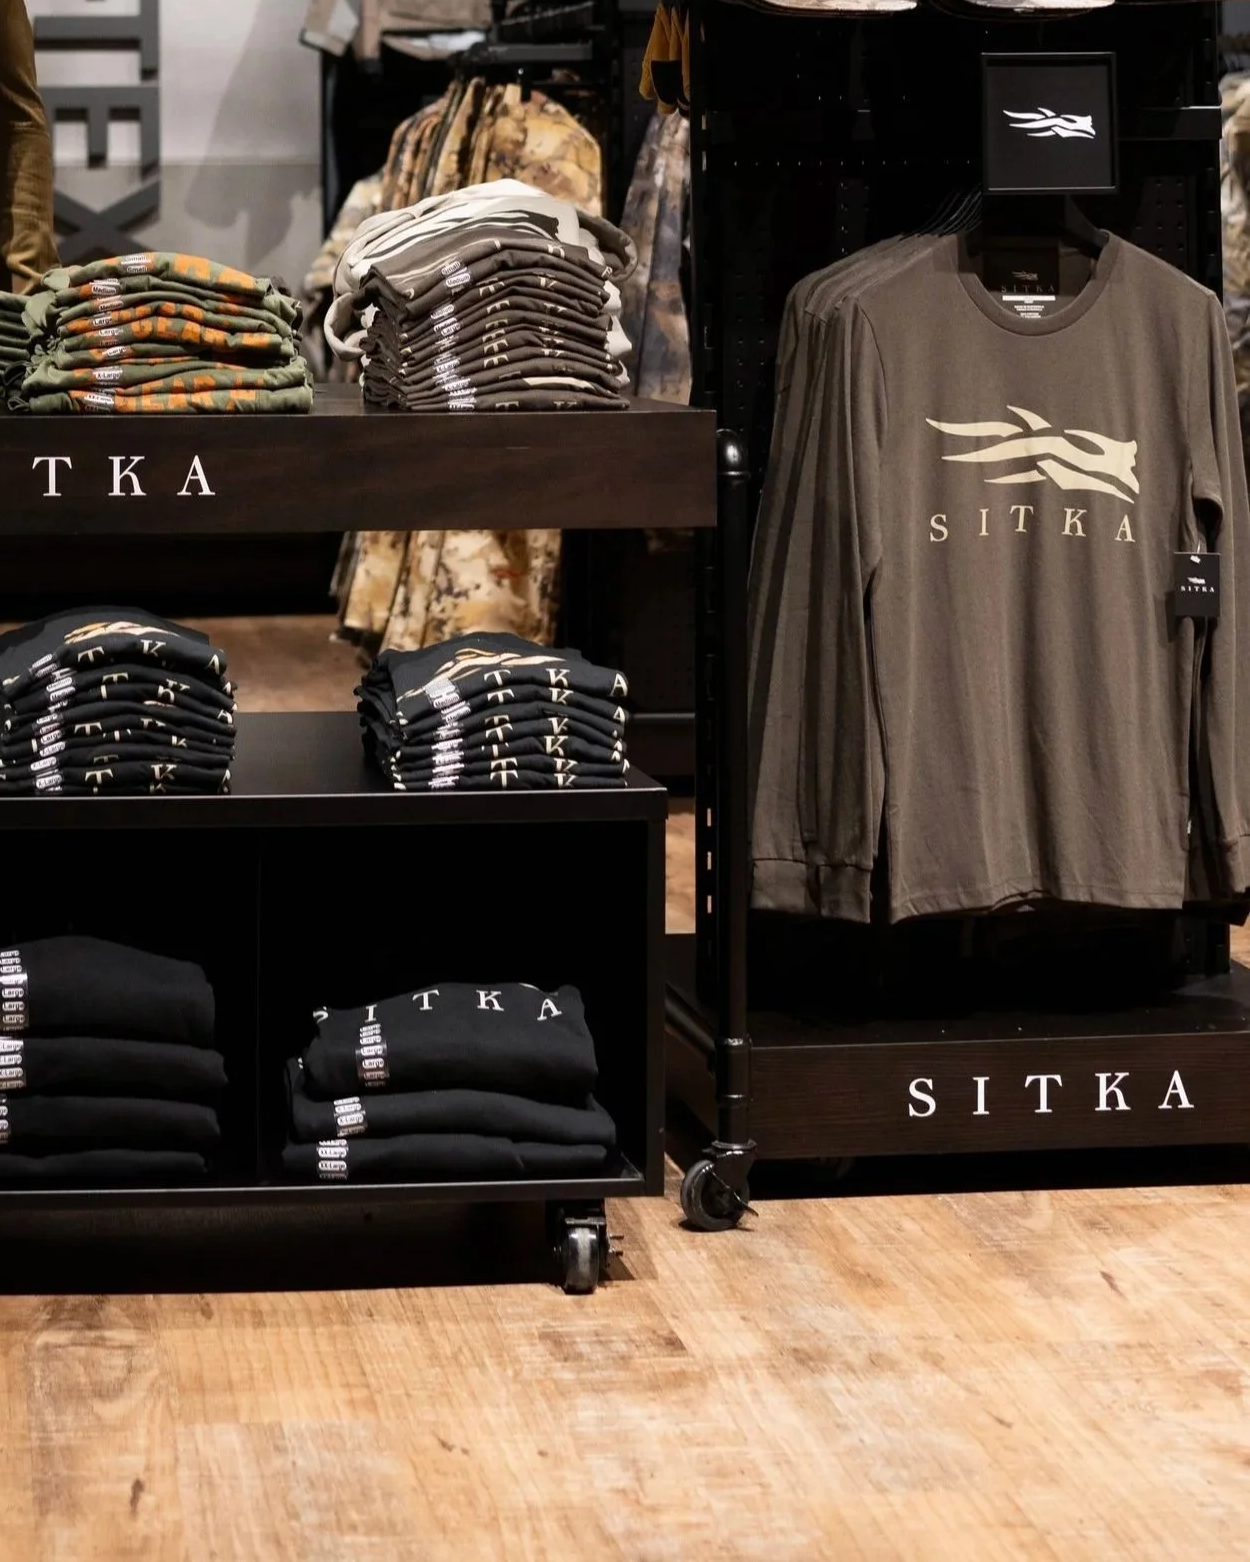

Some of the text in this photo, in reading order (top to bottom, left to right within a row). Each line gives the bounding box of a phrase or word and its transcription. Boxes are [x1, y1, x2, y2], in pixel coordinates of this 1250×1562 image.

[442, 261, 460, 274] Small
[447, 274, 470, 286] Medium
[92, 286, 117, 295] Medium
[97, 371, 120, 380] X-Large
[930, 505, 1136, 543] SITKA
[1181, 585, 1215, 593] SITKA
[37, 775, 62, 789] X-Large
[2, 987, 24, 998] Large
[2, 1000, 25, 1011] Large
[362, 1046, 383, 1056] Large
[363, 1058, 385, 1069] Large
[908, 1068, 1195, 1119] SITKA
